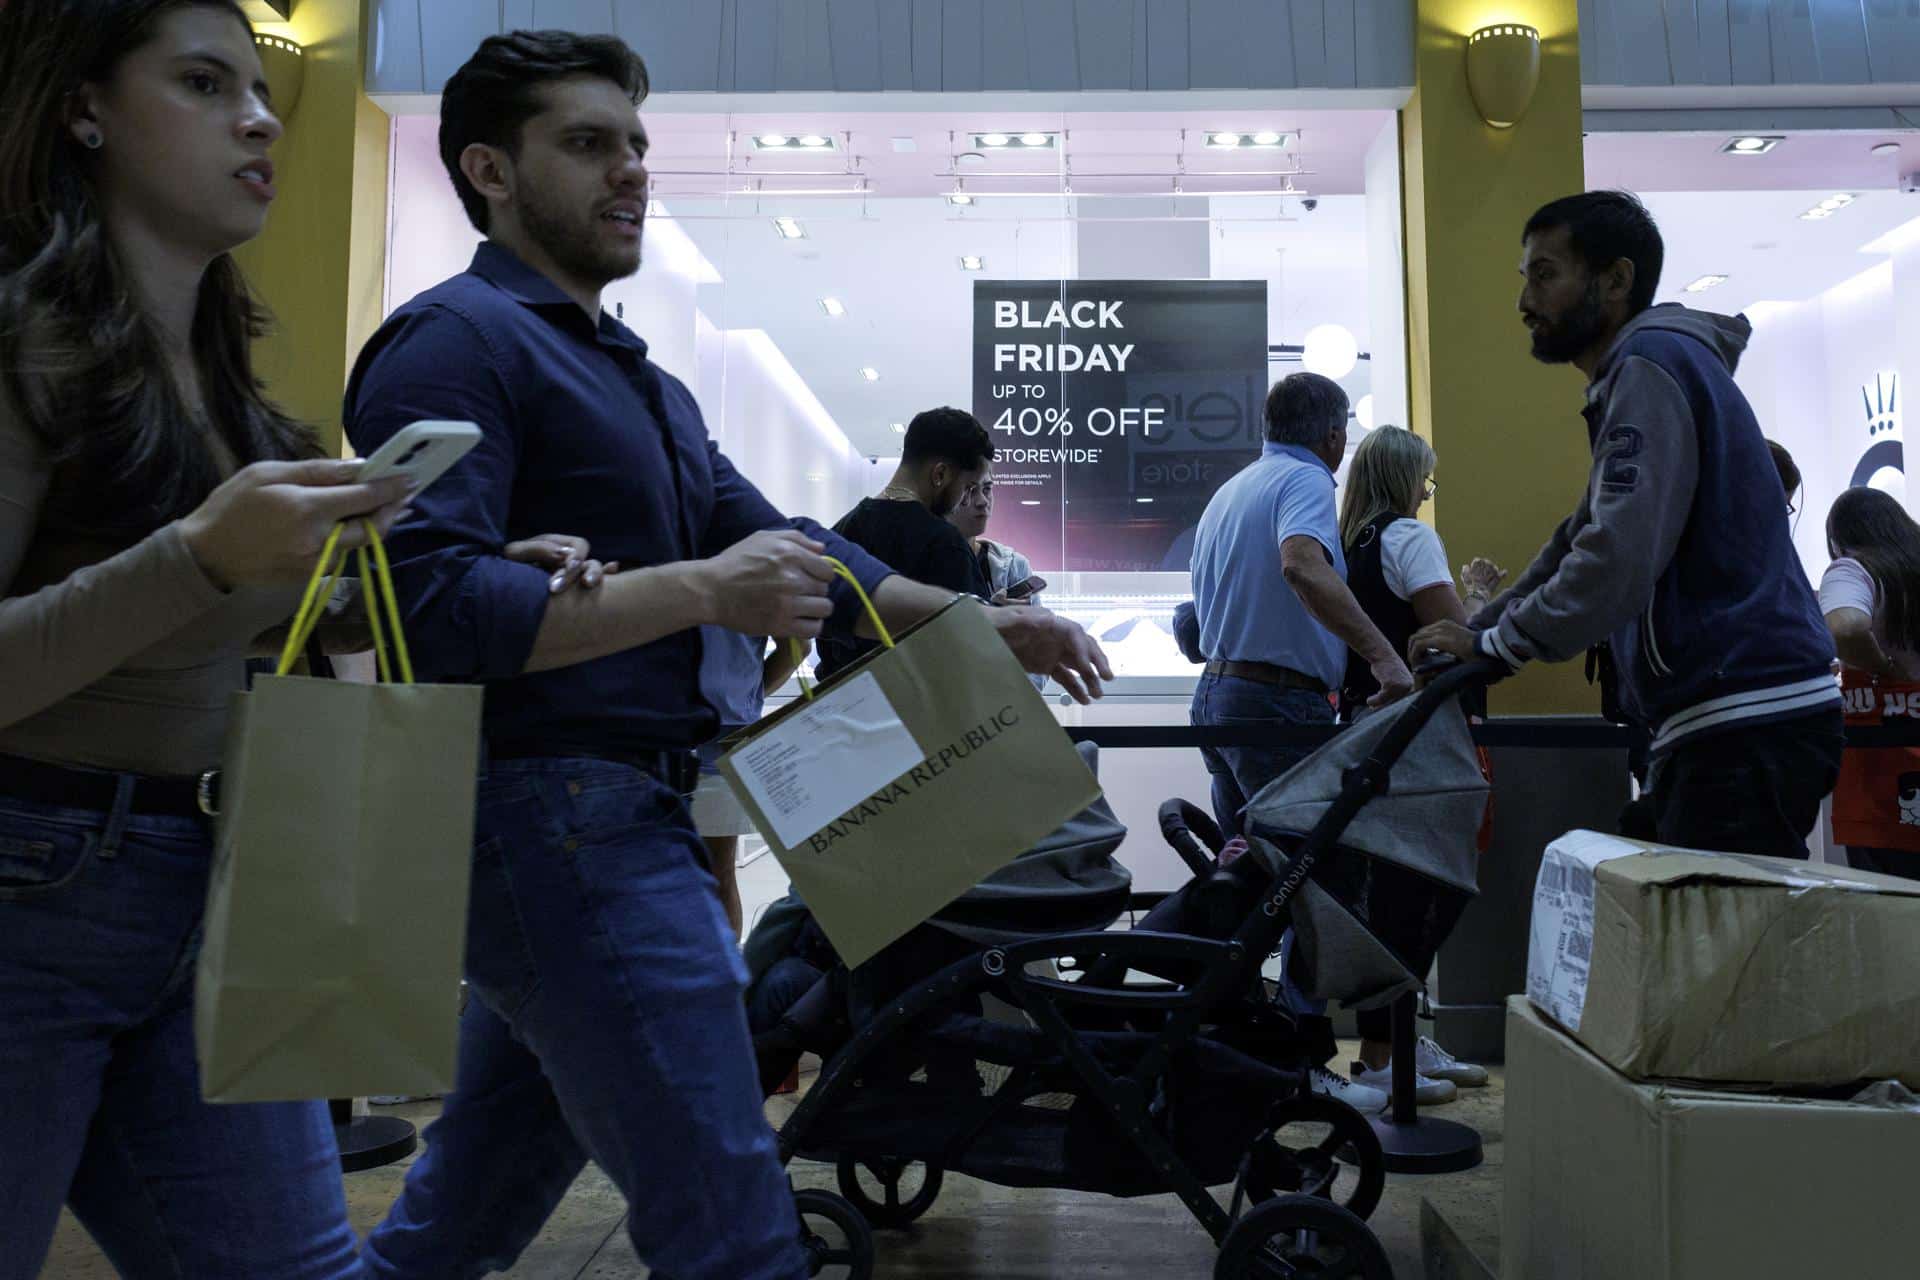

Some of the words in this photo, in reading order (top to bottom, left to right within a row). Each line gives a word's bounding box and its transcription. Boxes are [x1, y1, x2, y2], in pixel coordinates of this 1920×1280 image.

[994, 300, 1124, 328] BLACK
[993, 344, 1135, 372] FRIDAY
[992, 384, 1016, 399] UP
[1021, 384, 1046, 399] TO
[992, 407, 1074, 436] 40%
[1087, 407, 1165, 436] OFF
[1601, 424, 1641, 493] 2
[809, 782, 911, 854] BANANA
[910, 705, 1020, 788] REPUBLIC
[1263, 853, 1315, 917] Contours
